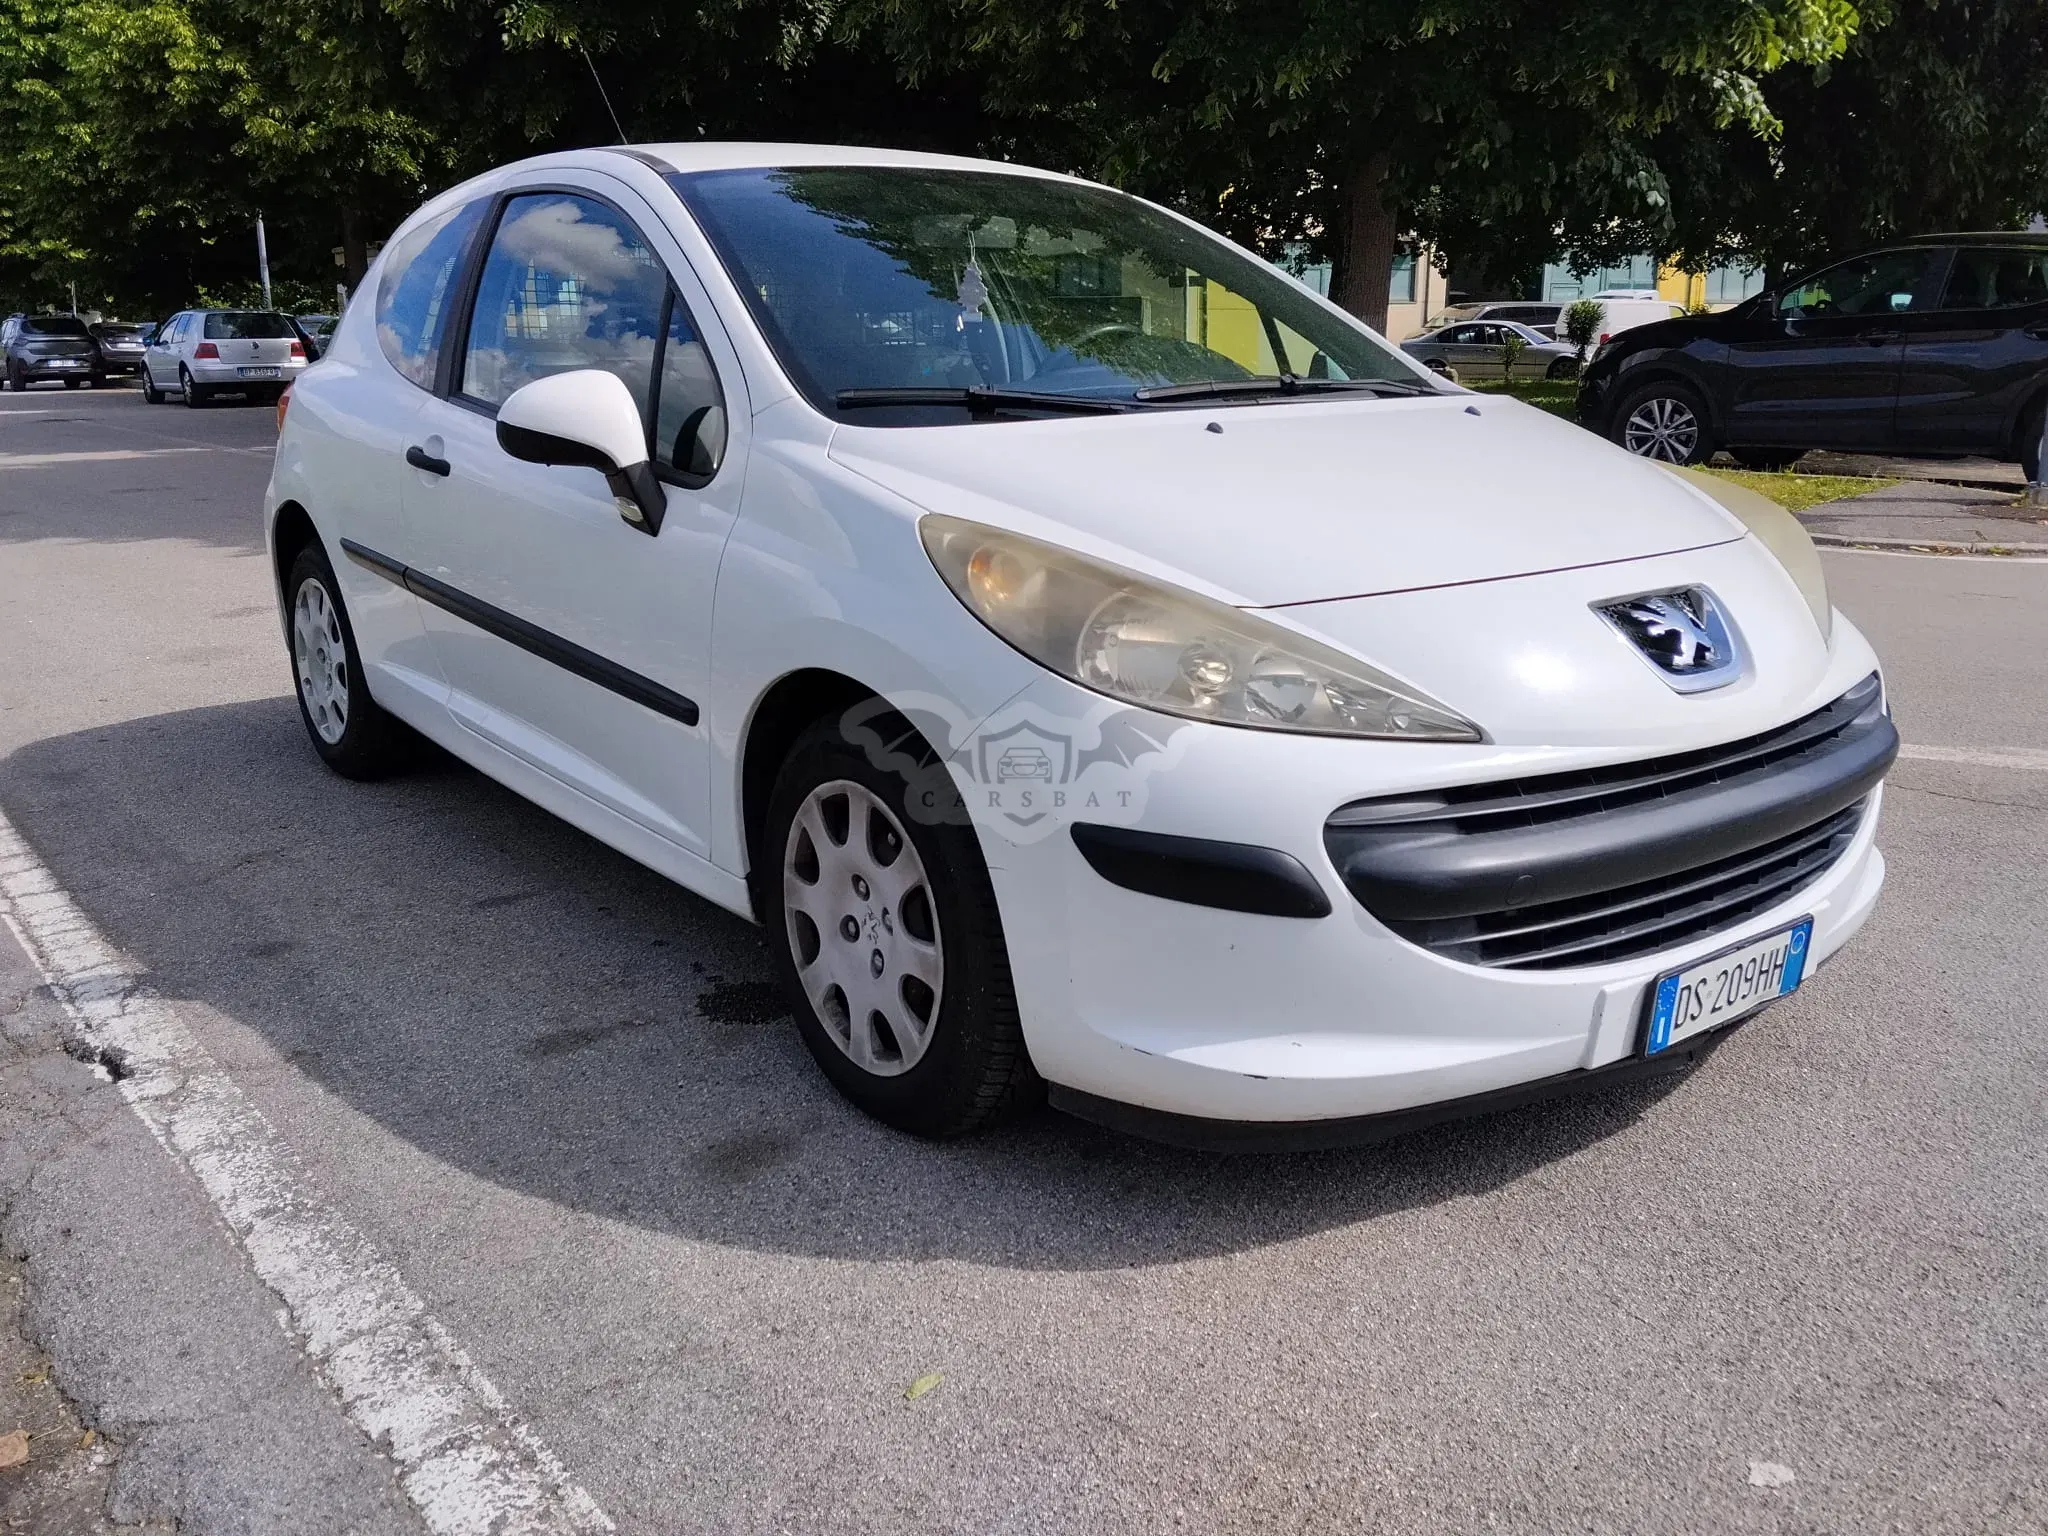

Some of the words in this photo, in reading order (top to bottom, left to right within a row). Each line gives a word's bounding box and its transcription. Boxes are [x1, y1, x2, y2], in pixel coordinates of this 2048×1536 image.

[1674, 978, 1707, 1030] DS
[1710, 944, 1788, 1014] 209HH
[1657, 1017, 1665, 1043] I
